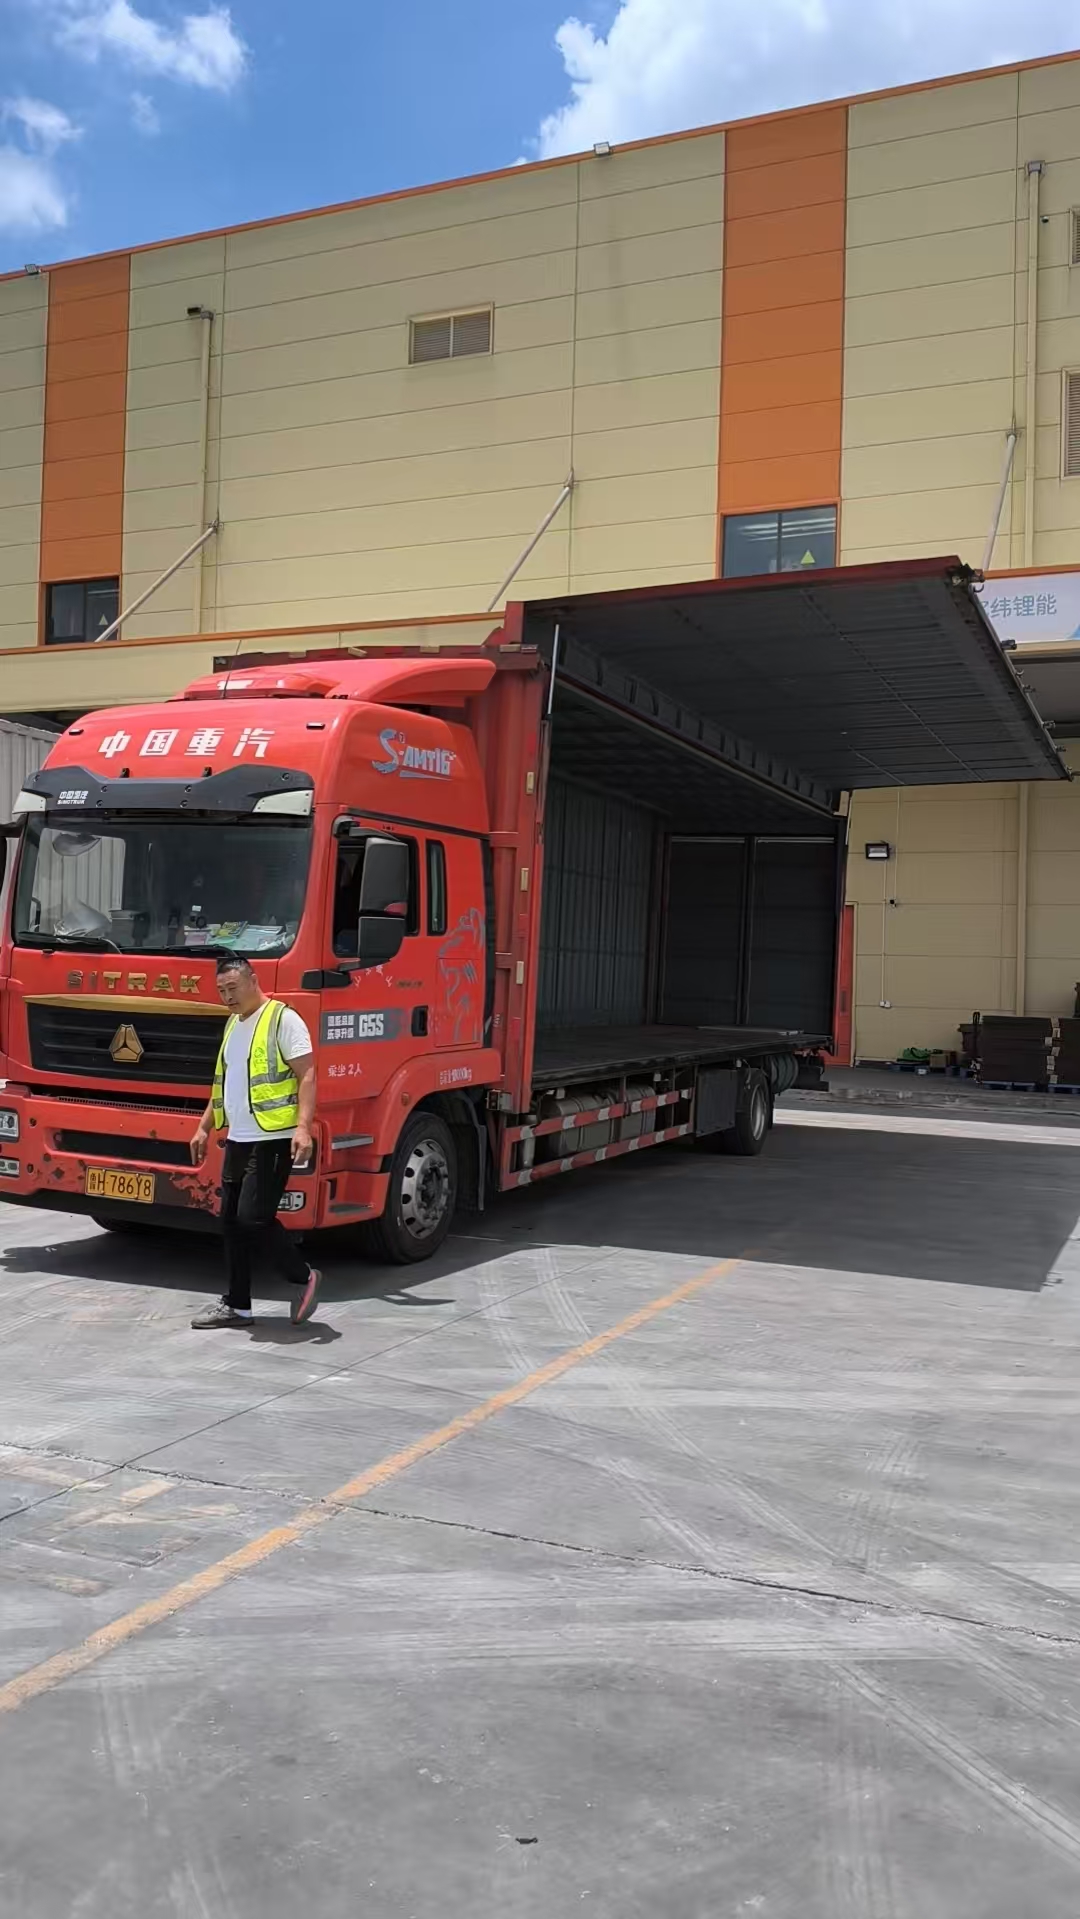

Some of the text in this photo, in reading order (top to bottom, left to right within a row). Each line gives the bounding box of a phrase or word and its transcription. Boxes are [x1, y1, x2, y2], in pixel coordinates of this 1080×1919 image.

[98, 727, 275, 758] 中国重汽
[68, 969, 202, 993] SITRAK
[359, 1013, 384, 1037] G5S
